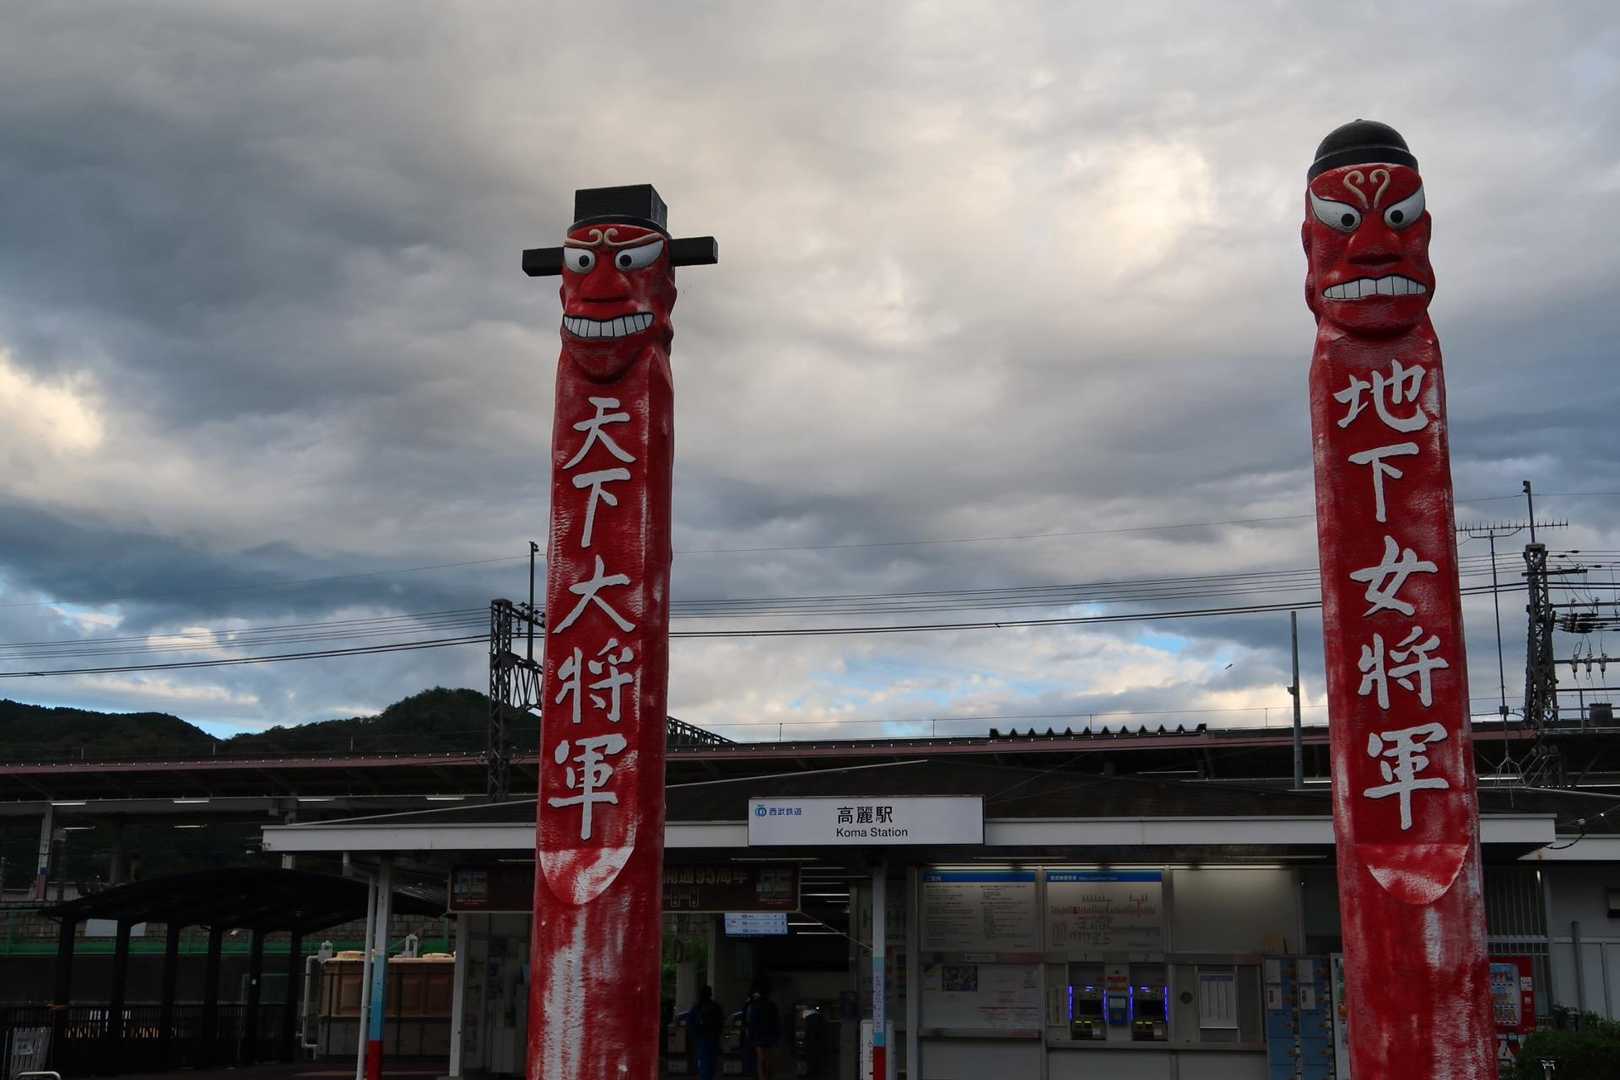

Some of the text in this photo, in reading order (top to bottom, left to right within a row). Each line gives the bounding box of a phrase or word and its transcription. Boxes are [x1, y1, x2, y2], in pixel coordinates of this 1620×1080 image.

[837, 806, 893, 824] 高麗駅
[836, 827, 908, 838] Koma Station
